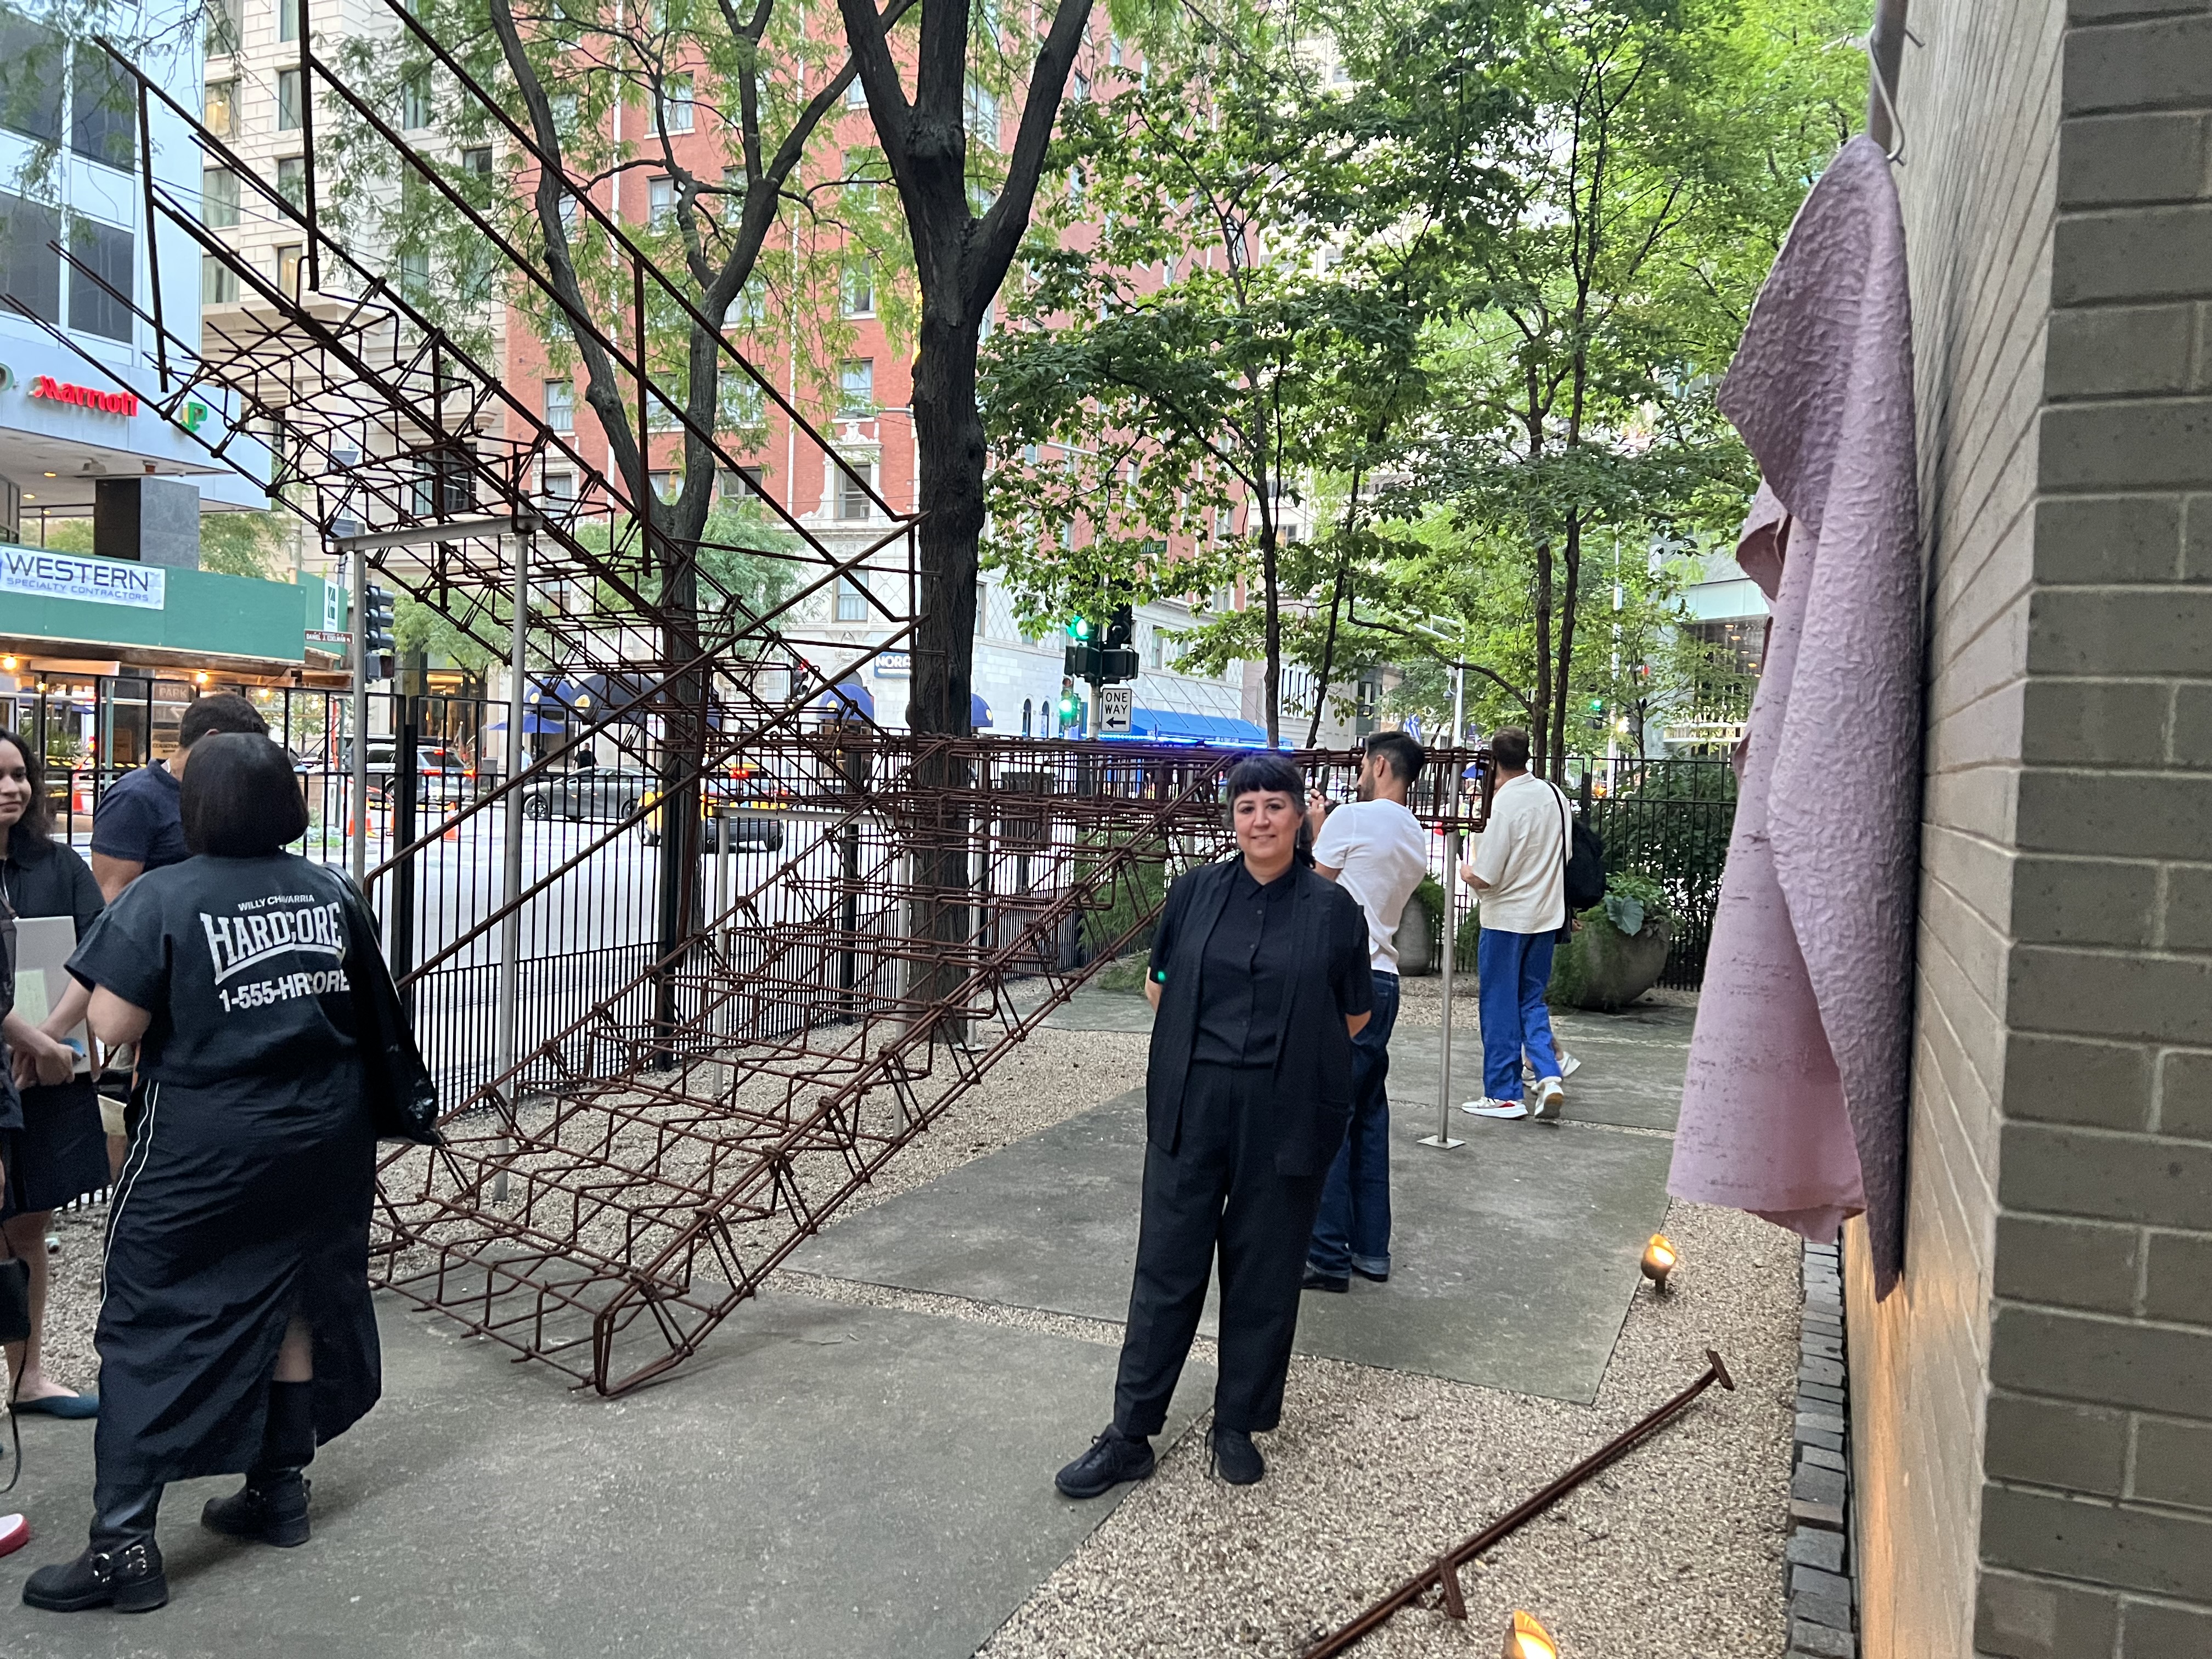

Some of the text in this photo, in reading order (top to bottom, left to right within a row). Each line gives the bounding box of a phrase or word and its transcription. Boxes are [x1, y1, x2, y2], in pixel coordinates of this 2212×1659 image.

[33, 375, 139, 417] Marriott
[5, 552, 149, 591] WESTERN
[7, 577, 149, 602] SPECIALTY CONTRACTORS
[159, 687, 187, 698] PARK
[1105, 692, 1128, 702] ONE
[1104, 704, 1128, 714] WAY
[238, 898, 266, 911] WILLY
[199, 901, 342, 985] HARDCORE
